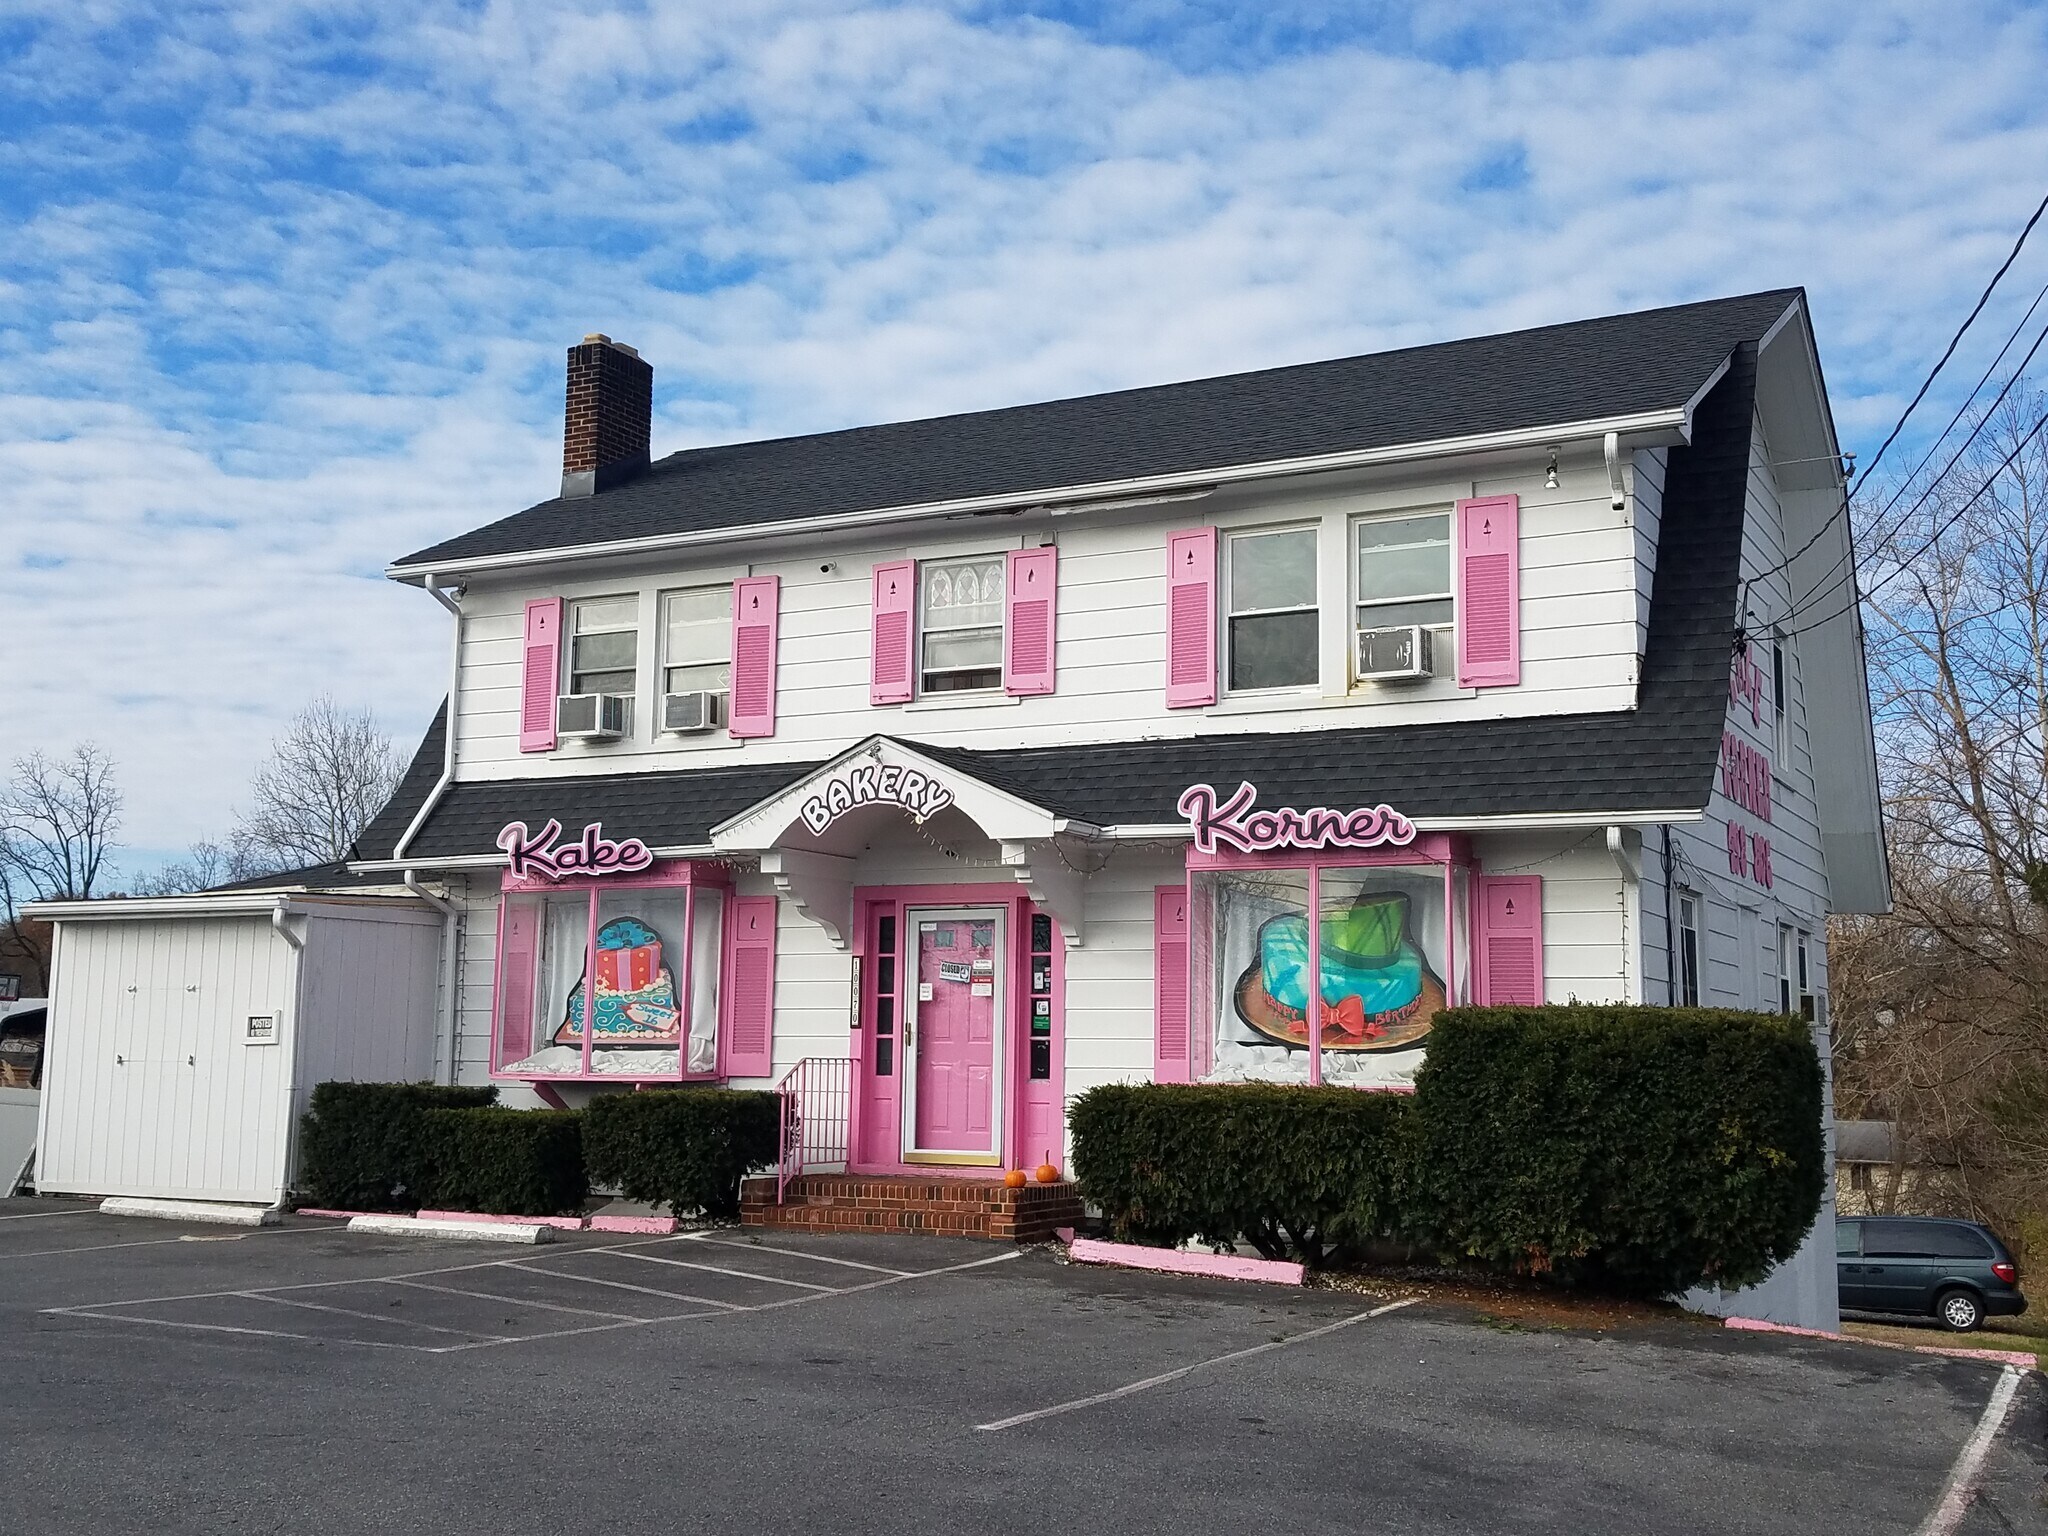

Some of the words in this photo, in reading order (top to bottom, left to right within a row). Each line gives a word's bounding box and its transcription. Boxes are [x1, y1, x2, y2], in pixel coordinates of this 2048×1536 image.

[800, 764, 954, 834] BAKERY
[1180, 784, 1413, 850] Korner
[498, 820, 651, 877] Kake
[941, 963, 961, 975] CLOSED
[643, 1014, 658, 1026] 16
[1264, 990, 1299, 1021] HAPPY
[251, 1018, 272, 1029] POSTED
